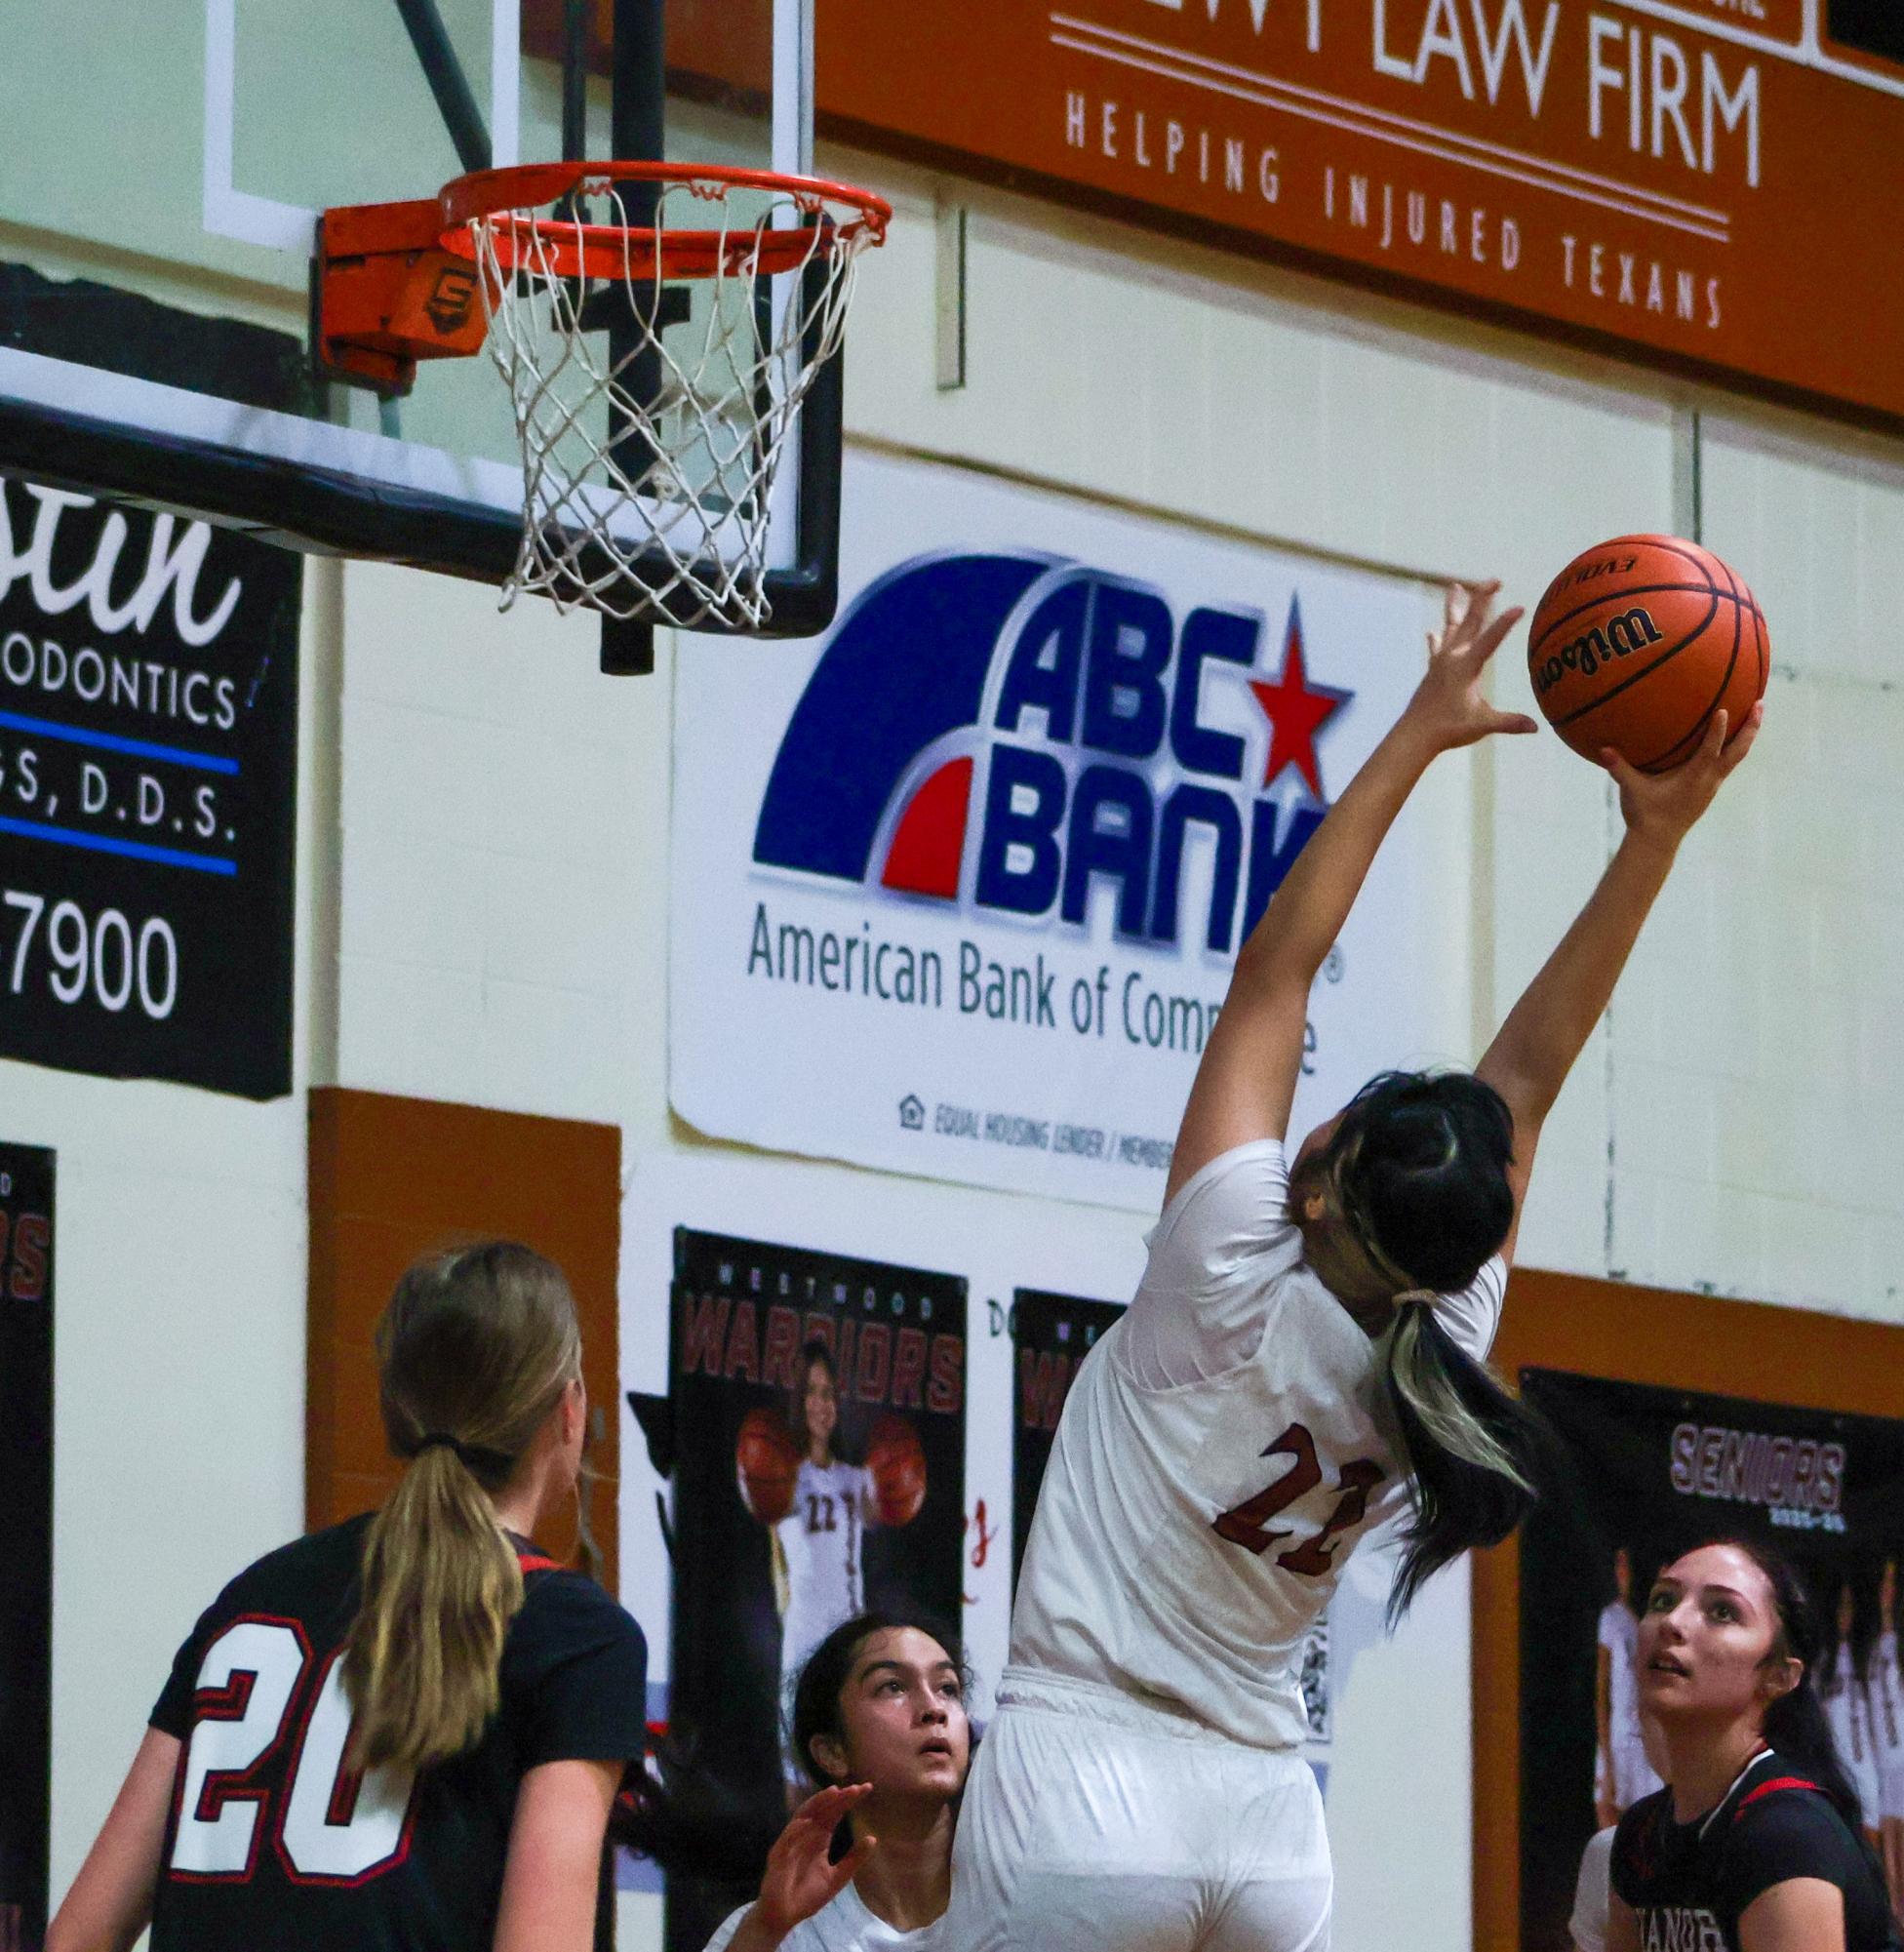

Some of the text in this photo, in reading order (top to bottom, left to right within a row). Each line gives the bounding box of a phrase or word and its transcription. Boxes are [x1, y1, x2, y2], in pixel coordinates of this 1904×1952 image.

[1372, 0, 1759, 187] LAW FIRM
[1066, 91, 1721, 329] HELPING INJURED TEXANS
[3, 633, 235, 730] ODONTICS
[993, 576, 1260, 780] ABC
[1535, 607, 1663, 695] Wilson
[81, 761, 235, 840] D.D.S.
[974, 742, 1331, 954] BANK
[4, 890, 178, 1019] 7900
[747, 902, 942, 1009] American
[959, 940, 1055, 1029] Bank
[1073, 966, 1109, 1039] of
[1671, 1423, 1845, 1510] SENIORS
[166, 1615, 417, 1887] 20
